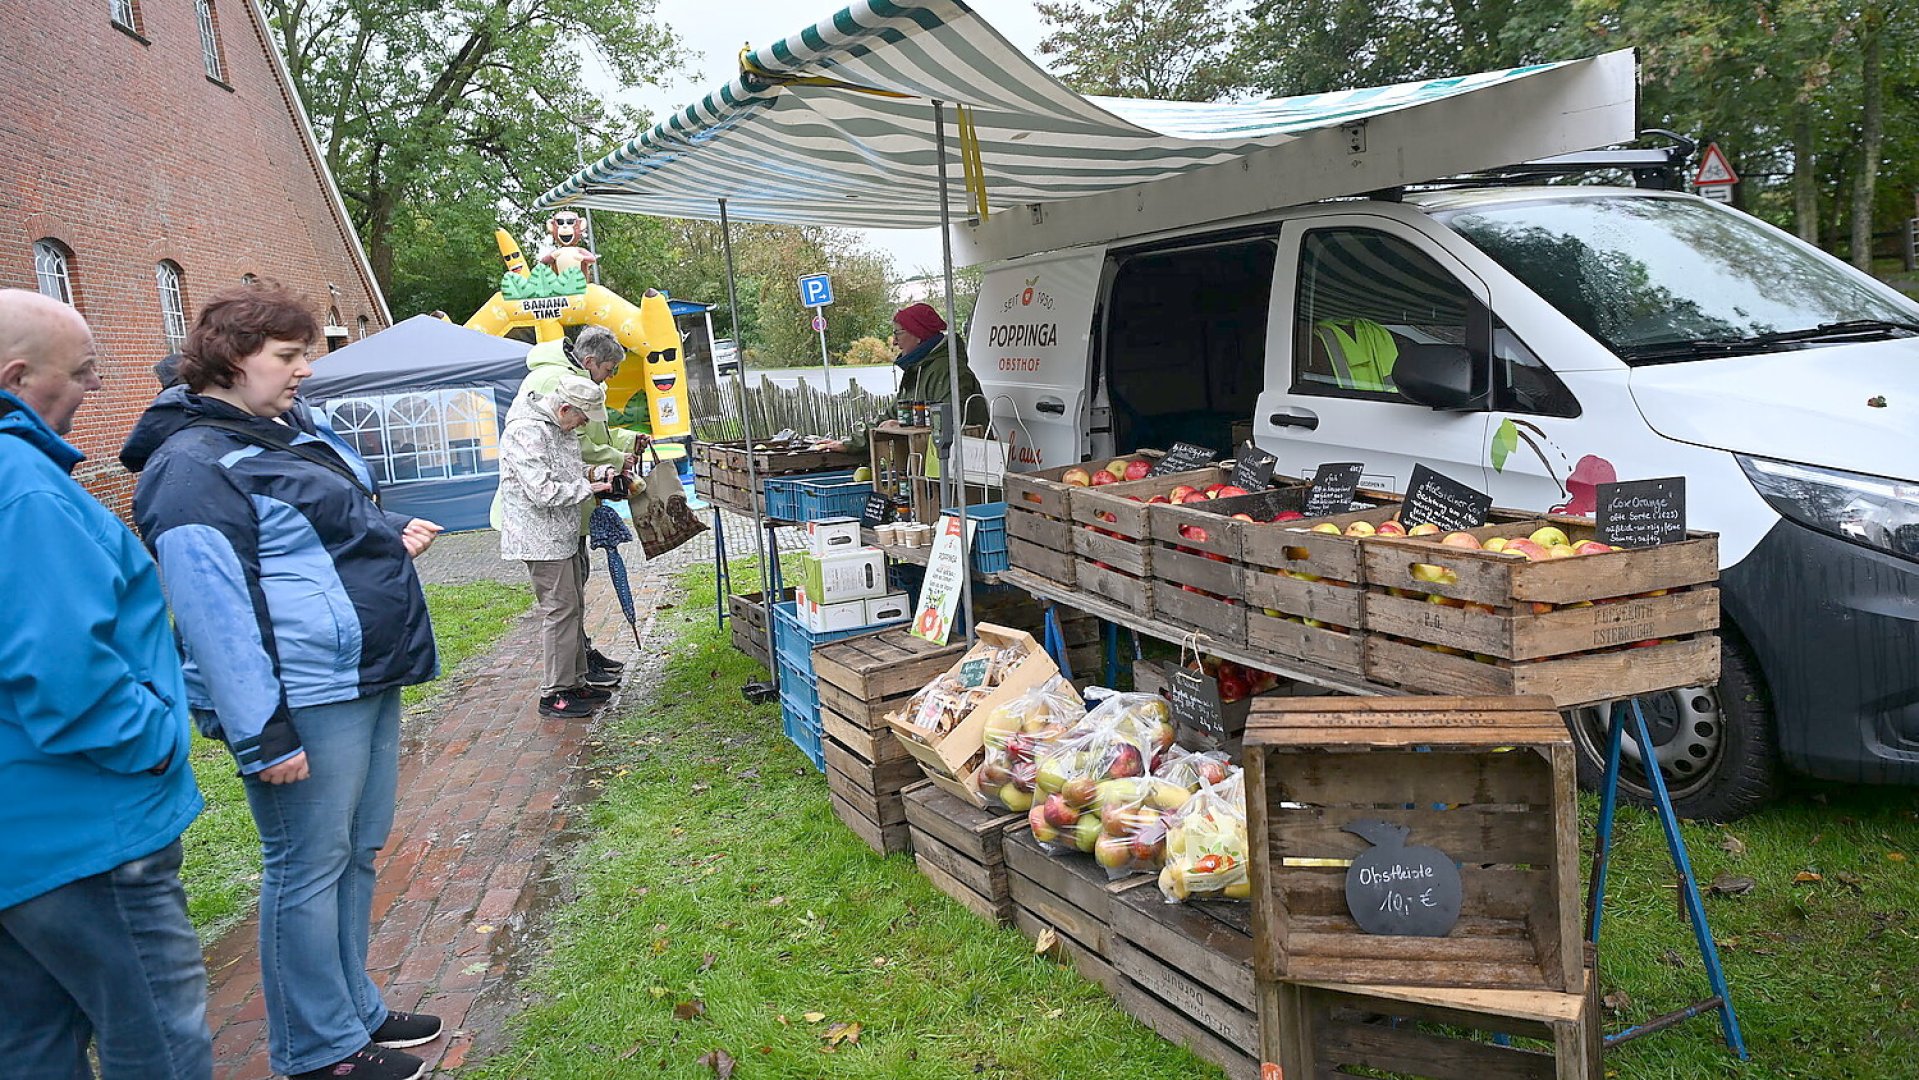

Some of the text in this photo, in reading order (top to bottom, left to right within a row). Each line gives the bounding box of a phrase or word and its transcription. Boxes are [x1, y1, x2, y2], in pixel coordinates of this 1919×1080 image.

[808, 280, 823, 302] P
[523, 298, 569, 310] BANANA
[533, 309, 561, 319] TIME
[989, 323, 1057, 347] POPPINGA
[998, 358, 1041, 371] OBSTHOF
[1360, 864, 1434, 885] Obstkiste
[1419, 887, 1438, 907] €
